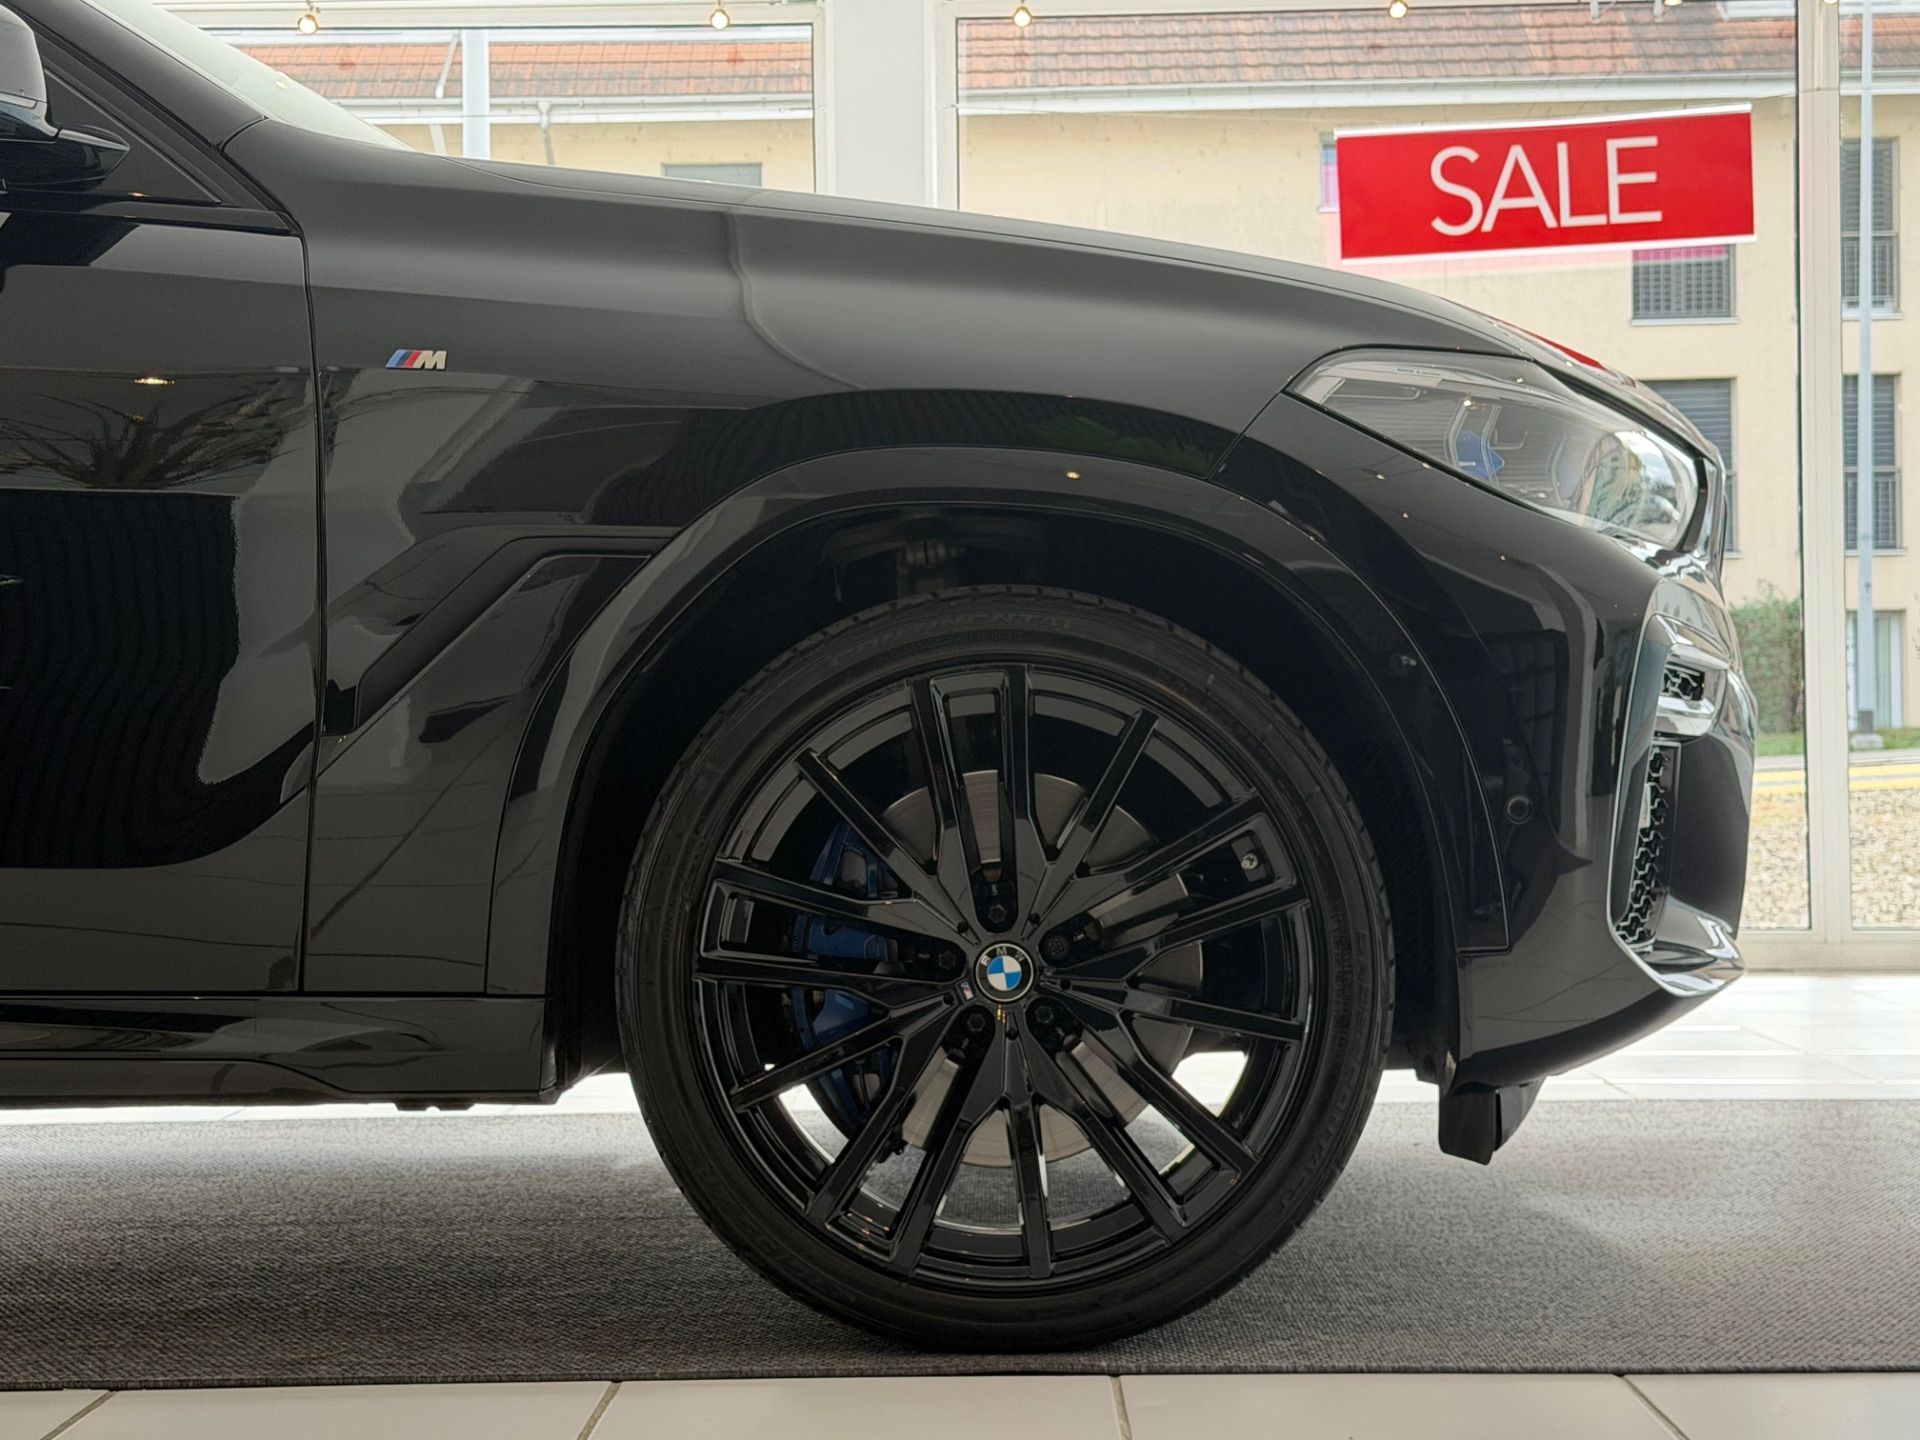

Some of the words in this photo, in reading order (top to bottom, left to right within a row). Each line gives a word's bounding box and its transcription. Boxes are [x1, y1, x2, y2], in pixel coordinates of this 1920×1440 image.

[1430, 136, 1662, 236] SALE
[411, 350, 447, 370] M
[981, 946, 1026, 967] BMW
